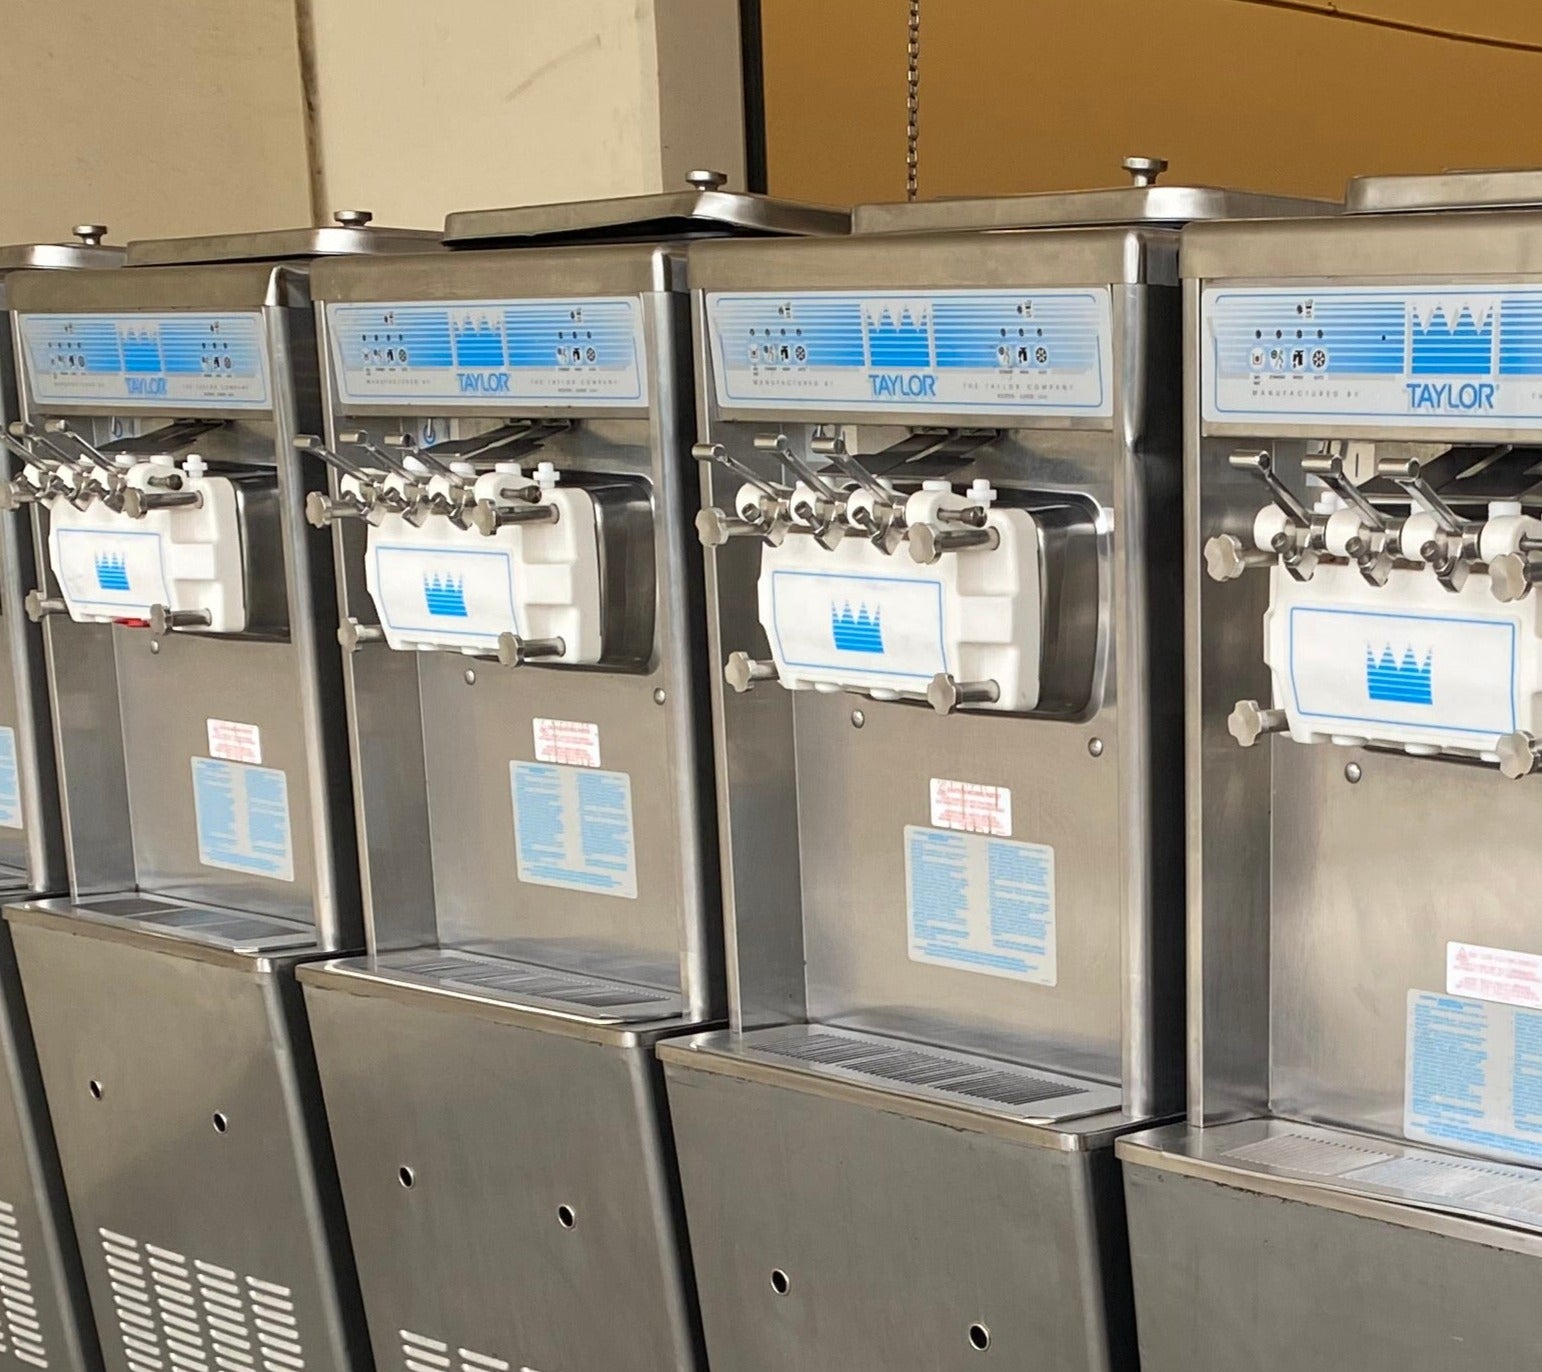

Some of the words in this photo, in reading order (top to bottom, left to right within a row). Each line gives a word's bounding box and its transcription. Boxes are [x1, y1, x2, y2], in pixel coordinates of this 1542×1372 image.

[456, 373, 511, 392] TAYLOR
[868, 374, 937, 396] TAYLOR
[1406, 383, 1495, 409] TAYLOR
